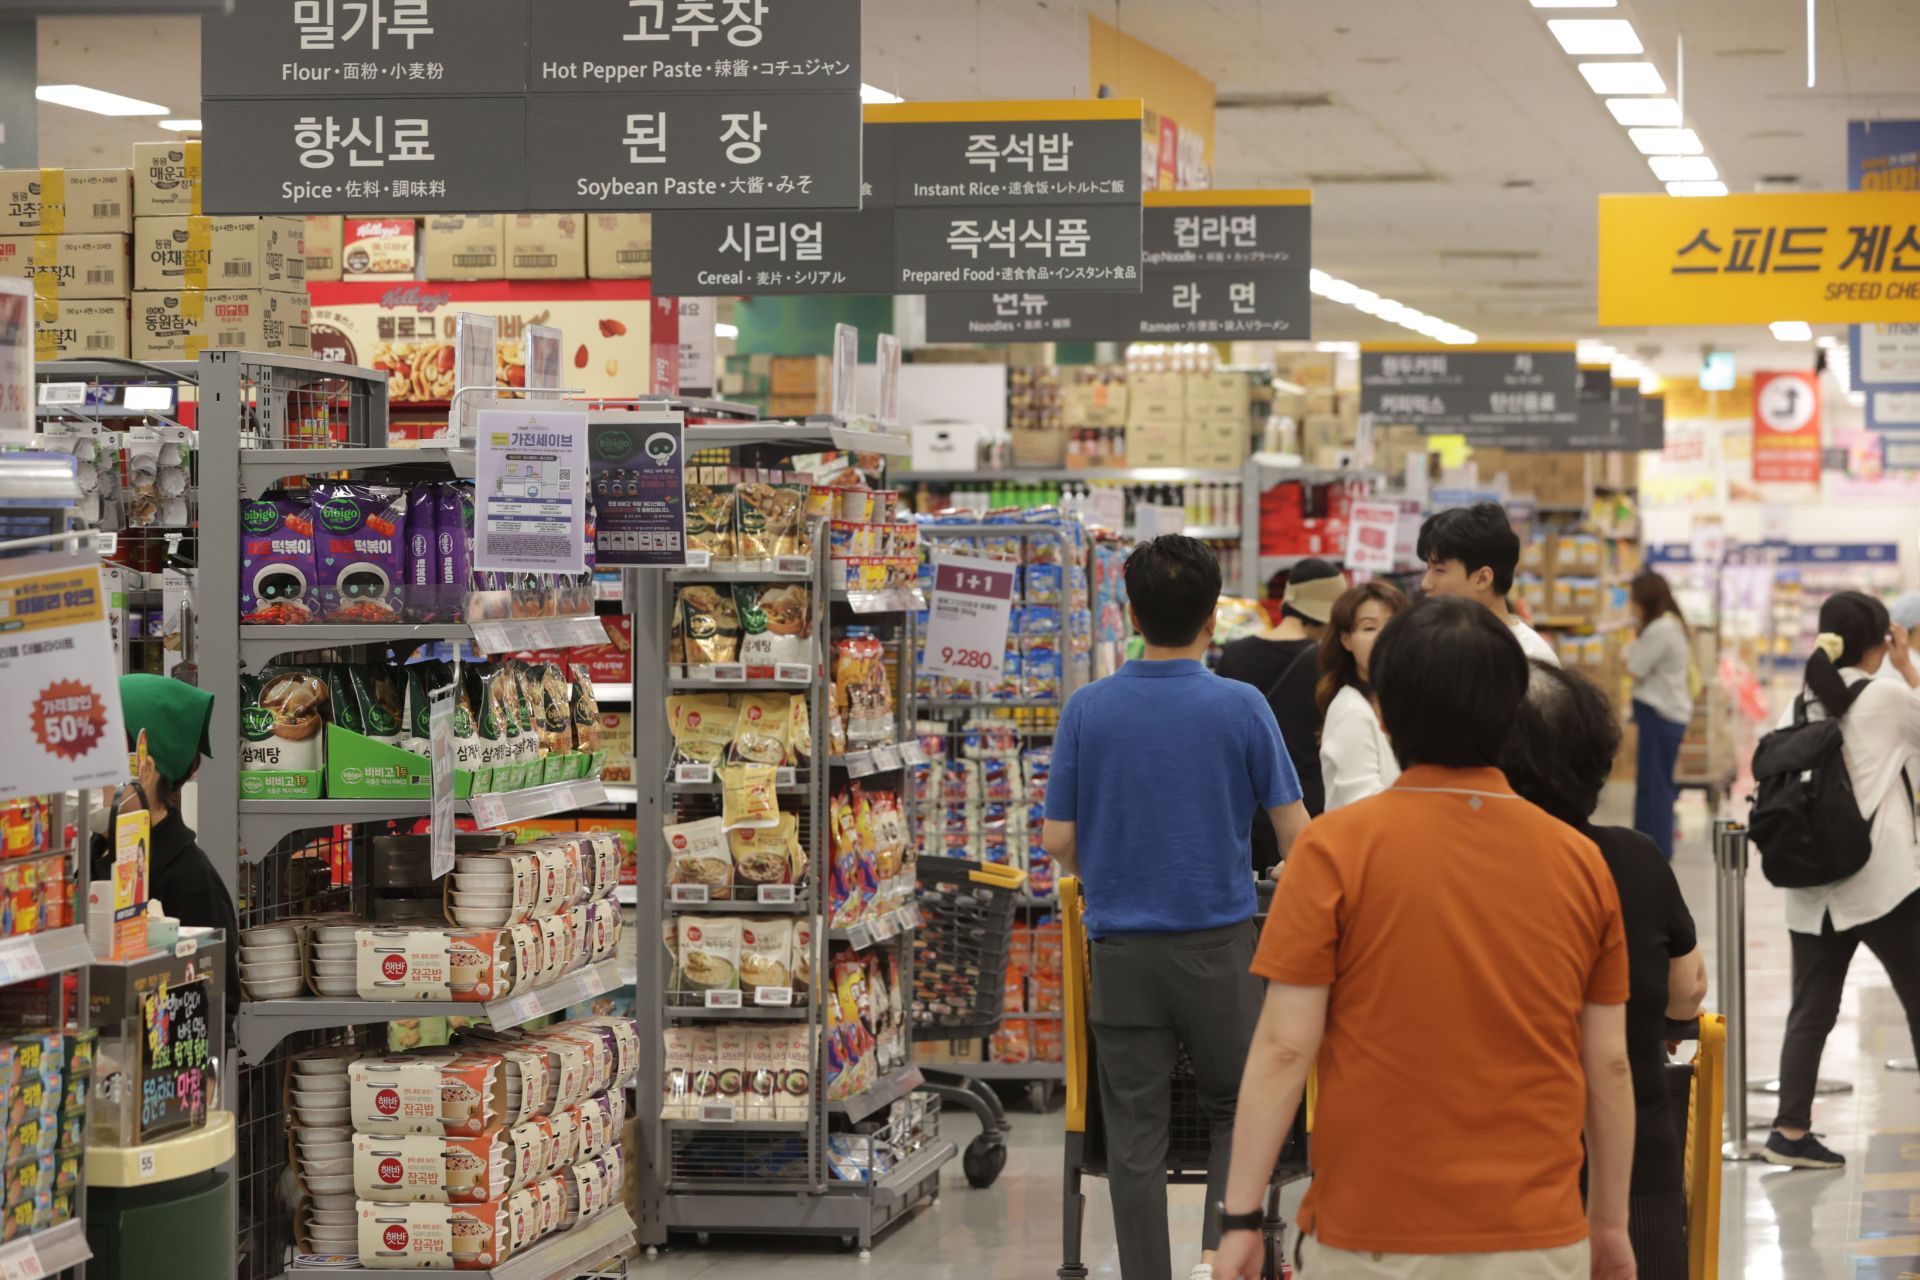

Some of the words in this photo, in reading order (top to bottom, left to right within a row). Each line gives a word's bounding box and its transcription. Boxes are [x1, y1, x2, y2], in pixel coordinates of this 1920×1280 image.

[295, 0, 433, 49] 밀가루
[623, 0, 768, 47] 고추장
[283, 63, 331, 80] Flour
[343, 63, 378, 80] 面粉
[391, 62, 443, 79] 小麦粉
[543, 62, 577, 78] Hot
[583, 62, 647, 83] Pepper
[653, 61, 702, 77] Paste
[761, 59, 849, 76] コチュジャン
[294, 116, 434, 168] 향신료
[623, 112, 666, 163] 된
[720, 111, 767, 164] 장
[965, 133, 1073, 172] 즉석밥
[282, 181, 332, 203] Spice
[345, 180, 380, 198] 佐料
[393, 180, 446, 197] 調味料
[578, 177, 657, 197] Soybean
[665, 178, 716, 194] Paste
[730, 176, 764, 193] 大酱
[776, 176, 812, 193] みそ
[915, 184, 965, 196] Instant
[970, 182, 999, 195] Rice
[1009, 181, 1048, 194] 速食饭
[1057, 180, 1124, 193] レトルトご飯
[947, 219, 1090, 258] 즉석식품
[1174, 215, 1256, 247] 컵라면
[719, 222, 822, 261] 시리얼
[1671, 228, 1826, 273] 스피드
[698, 270, 742, 284] Cereal
[757, 272, 782, 285] 麦片
[795, 271, 845, 284] シリアル
[903, 268, 959, 285] Prepared
[964, 267, 994, 280] Food
[1002, 267, 1048, 280] 速食食品
[1053, 266, 1136, 279] インスタント食品
[1173, 283, 1201, 314] 라
[1230, 282, 1255, 313] 면
[1826, 283, 1881, 301] SPEED
[1140, 321, 1180, 333] Ramen
[511, 432, 573, 448] 가전세이브
[956, 572, 992, 592] 1+1
[942, 647, 992, 669] 9,280
[45, 714, 95, 743] 50%
[242, 747, 280, 764] 삼계탕
[384, 961, 405, 975] 햇반
[411, 968, 443, 982] 잡곡밥
[377, 1096, 398, 1109] 햇반
[403, 1103, 434, 1117] 잡곡밥
[141, 1158, 152, 1170] 55
[380, 1165, 401, 1178] 햇반
[407, 1172, 438, 1185] 잡곡밥
[385, 1232, 406, 1245] 햇반
[412, 1238, 444, 1252] 잡곡밥
